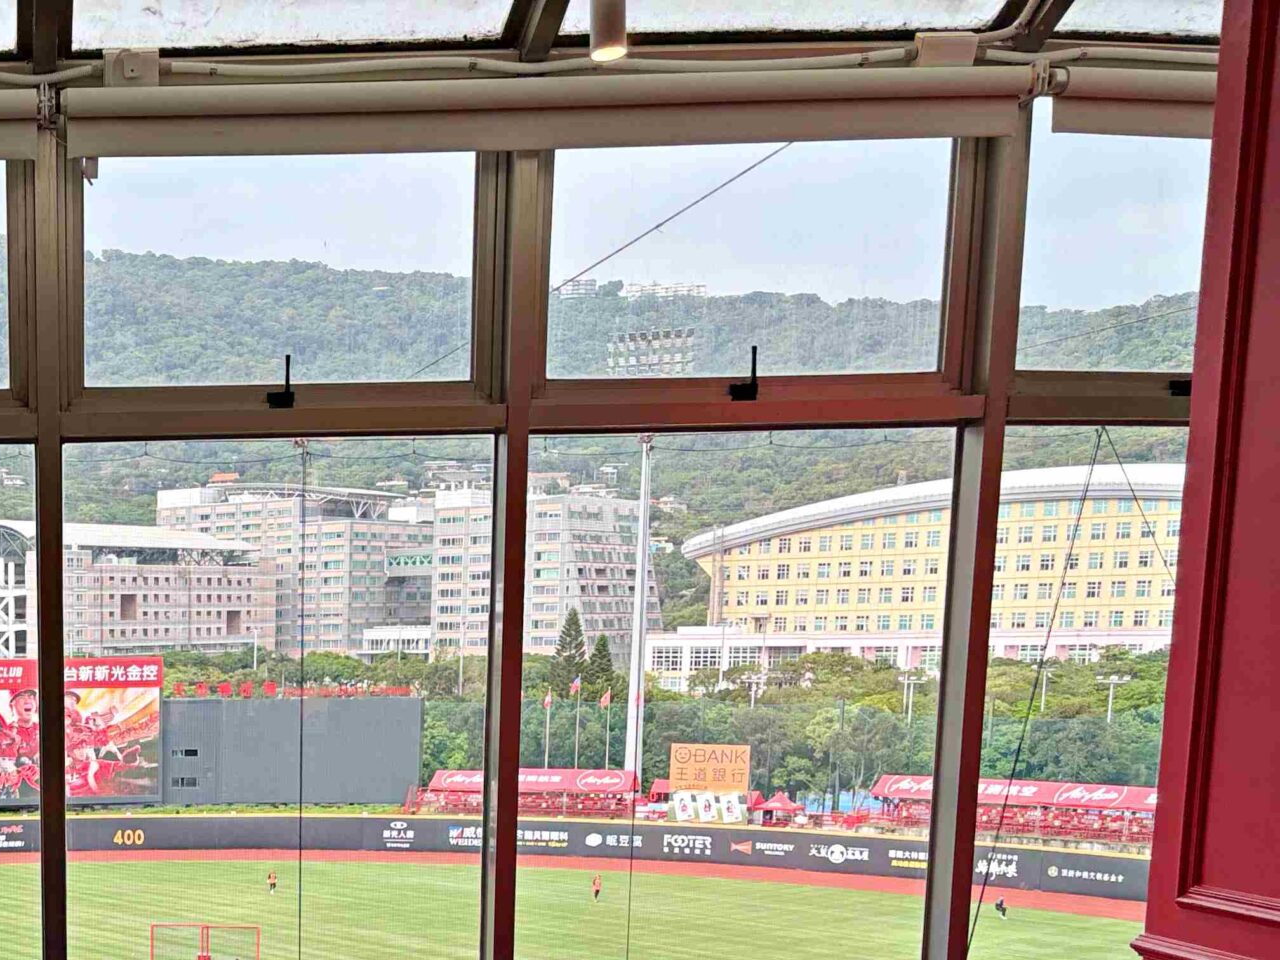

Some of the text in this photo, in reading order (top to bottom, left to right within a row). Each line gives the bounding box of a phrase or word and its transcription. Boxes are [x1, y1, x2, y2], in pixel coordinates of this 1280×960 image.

[64, 665, 158, 681] 台新新光金控
[675, 767, 746, 783] 王道銀行
[112, 829, 145, 845] 400
[663, 834, 712, 849] FOOTER
[755, 842, 795, 852] SUNTORY
